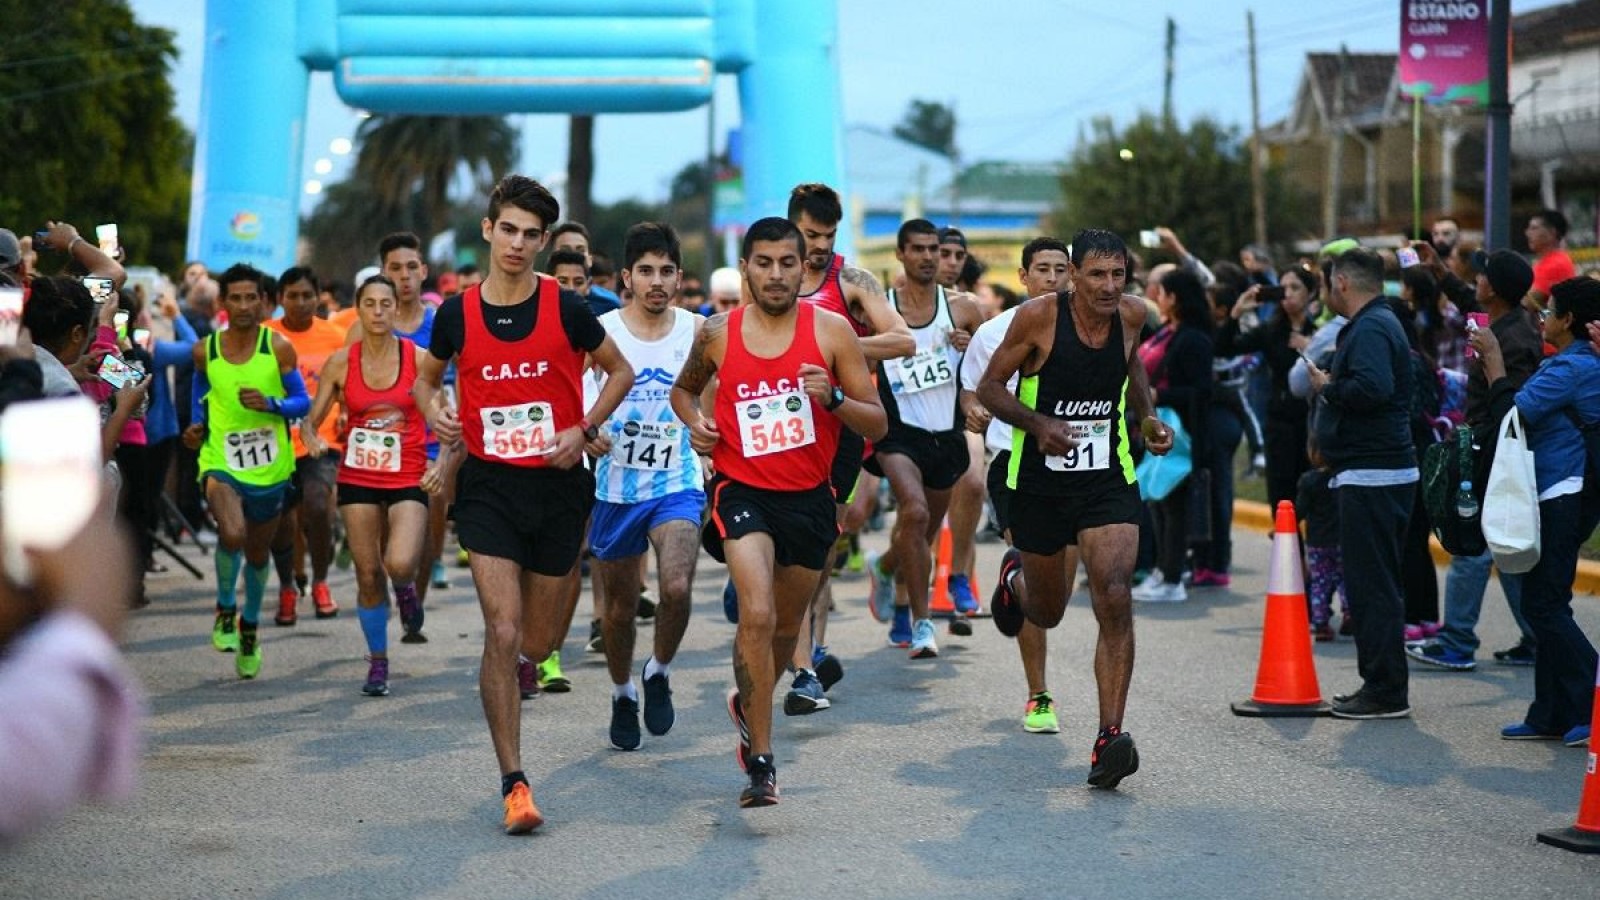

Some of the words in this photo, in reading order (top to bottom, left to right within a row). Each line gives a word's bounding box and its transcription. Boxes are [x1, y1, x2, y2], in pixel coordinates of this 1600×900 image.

[1408, 2, 1480, 20] ESTADIO
[482, 361, 549, 381] C.A.C.F
[908, 360, 952, 388] 145
[1054, 400, 1113, 416] LUCHO
[494, 426, 546, 454] 564
[750, 417, 806, 451] 543
[233, 443, 272, 468] 111
[355, 446, 393, 469] 562
[623, 440, 673, 468] 141
[1063, 442, 1094, 469] 91
